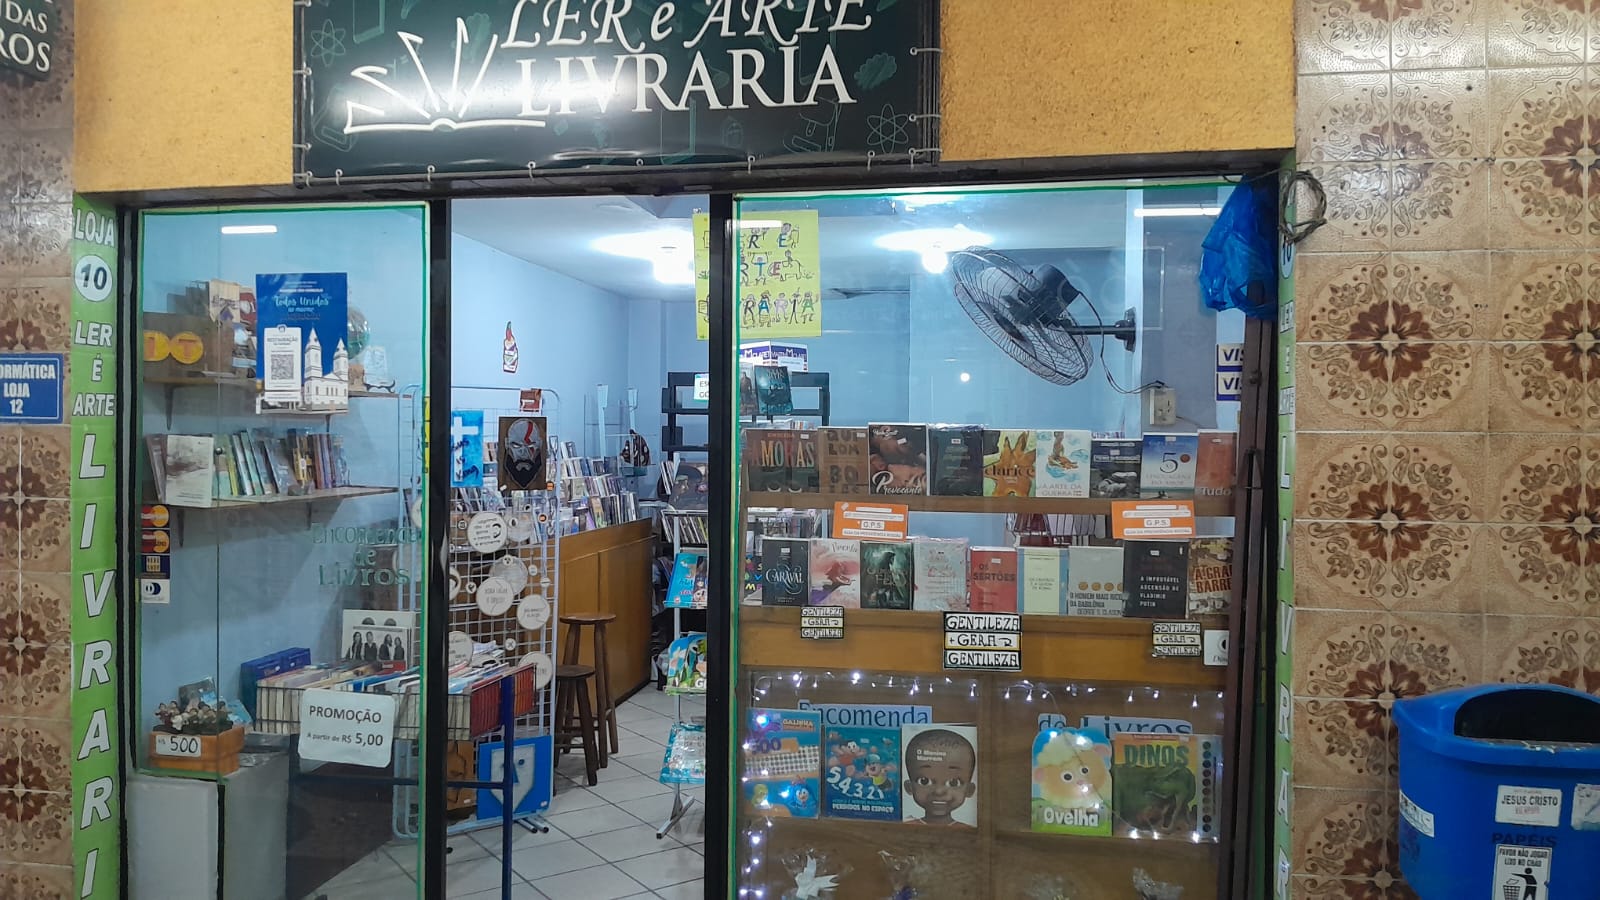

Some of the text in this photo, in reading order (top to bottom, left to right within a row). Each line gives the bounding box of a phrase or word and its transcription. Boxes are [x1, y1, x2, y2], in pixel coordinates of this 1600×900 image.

[499, 0, 872, 53] LER e ARTE
[515, 43, 857, 117] LIVRARIA
[75, 209, 115, 247] LOJA
[80, 264, 107, 291] 10
[74, 320, 113, 347] LER
[91, 354, 104, 382] É
[3, 382, 30, 398] LOJA
[9, 398, 24, 414] 12
[72, 393, 115, 417] ARTE
[1159, 452, 1178, 474] 5
[1200, 487, 1232, 496] Tudo
[318, 560, 411, 586] Livros
[765, 566, 805, 584] CARAVAL
[946, 615, 1019, 631] GENTILEZA
[957, 633, 997, 647] GERA
[948, 652, 1018, 667] GENTILEZA
[309, 705, 382, 724] PROMOÇÃO
[354, 732, 384, 747] 5,00
[1124, 744, 1190, 769] DINOS
[1501, 795, 1559, 807] JESUS CRISTO
[1043, 807, 1099, 828] Ovelha
